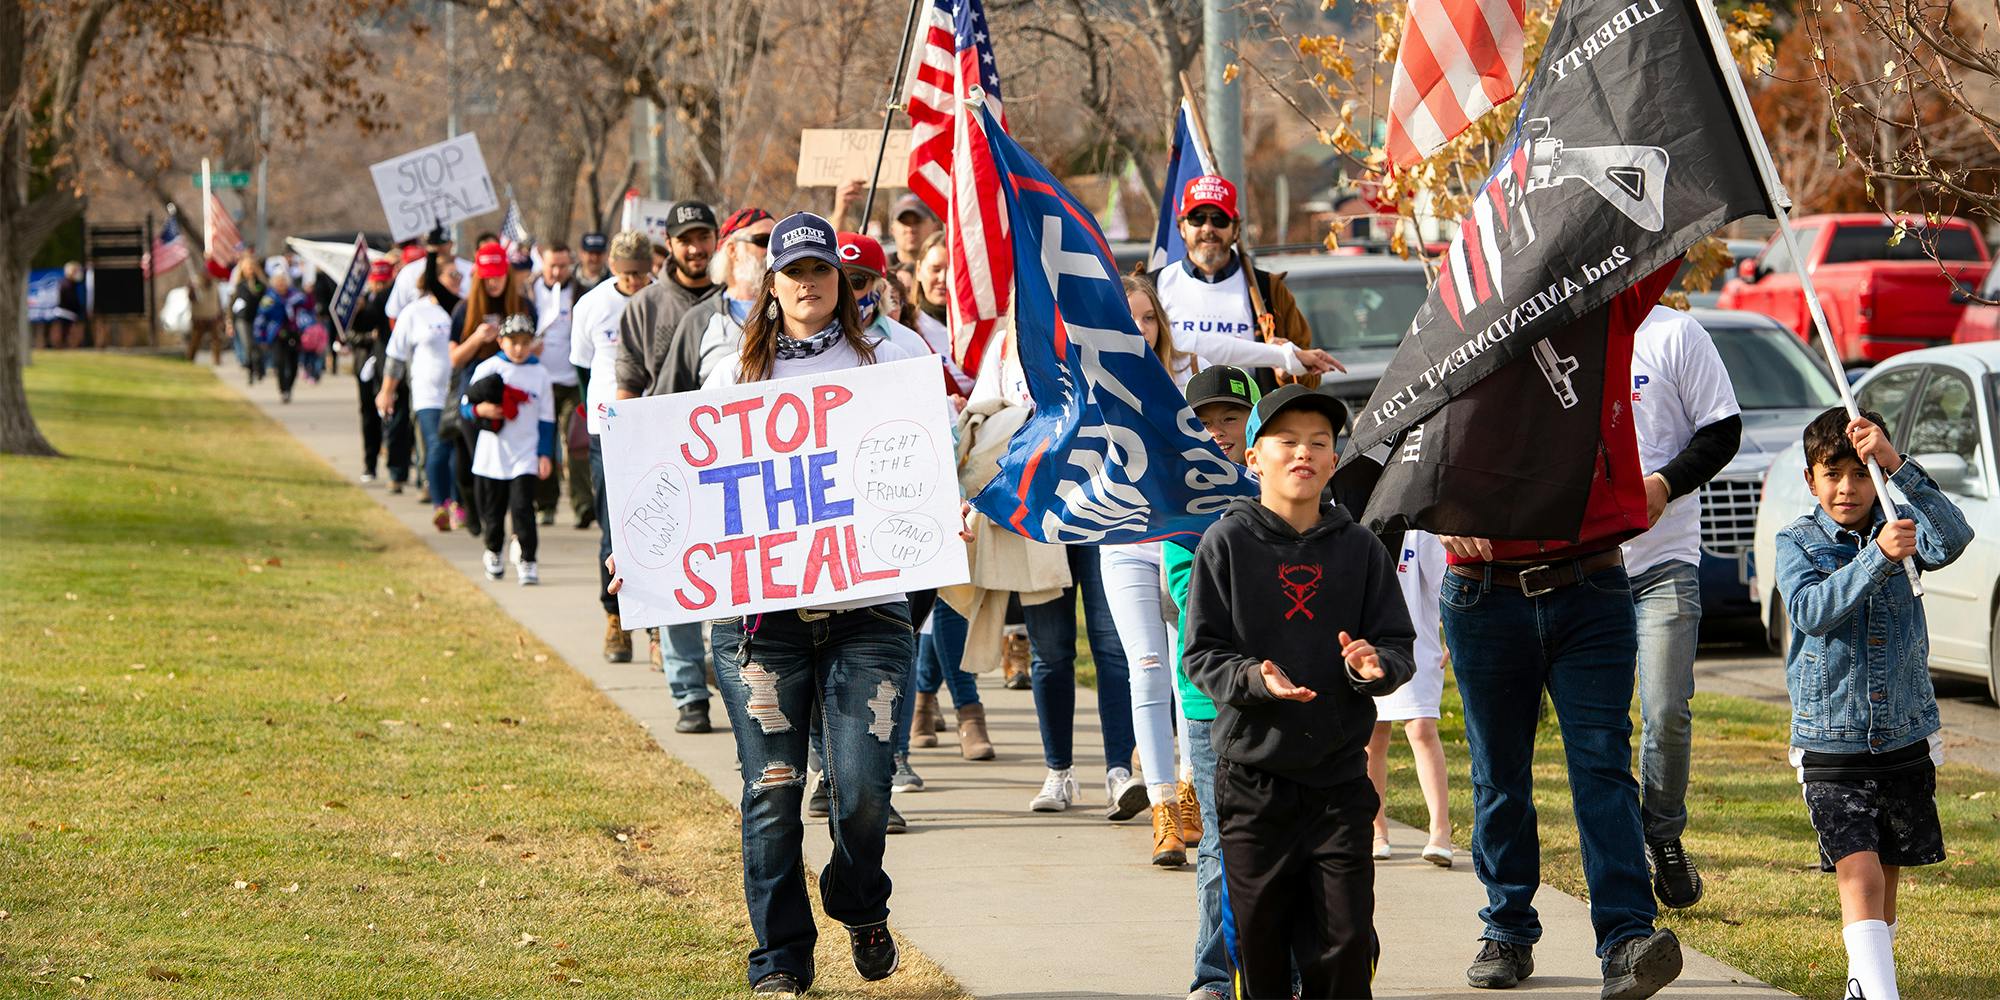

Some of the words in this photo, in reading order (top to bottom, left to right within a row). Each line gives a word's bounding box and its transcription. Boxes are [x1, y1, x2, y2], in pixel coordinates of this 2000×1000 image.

[398, 144, 464, 197] STOP
[812, 156, 845, 179] THE
[863, 154, 908, 183] VOT
[1199, 176, 1221, 185] KEEP
[1190, 184, 1229, 196] AMERICA
[1194, 191, 1223, 201] GREAT
[782, 226, 824, 243] TRUMP
[1171, 321, 1249, 334] TRUMP
[680, 384, 853, 468] STOP
[858, 434, 921, 455] FIGHT
[880, 455, 915, 473] THE
[699, 450, 855, 537] THE
[866, 482, 923, 501] FRAUD!
[624, 472, 681, 538] TRUMP
[649, 513, 679, 556] WON!
[879, 518, 934, 544] STAND
[891, 543, 922, 567] UP!
[674, 524, 901, 611] STEAL
